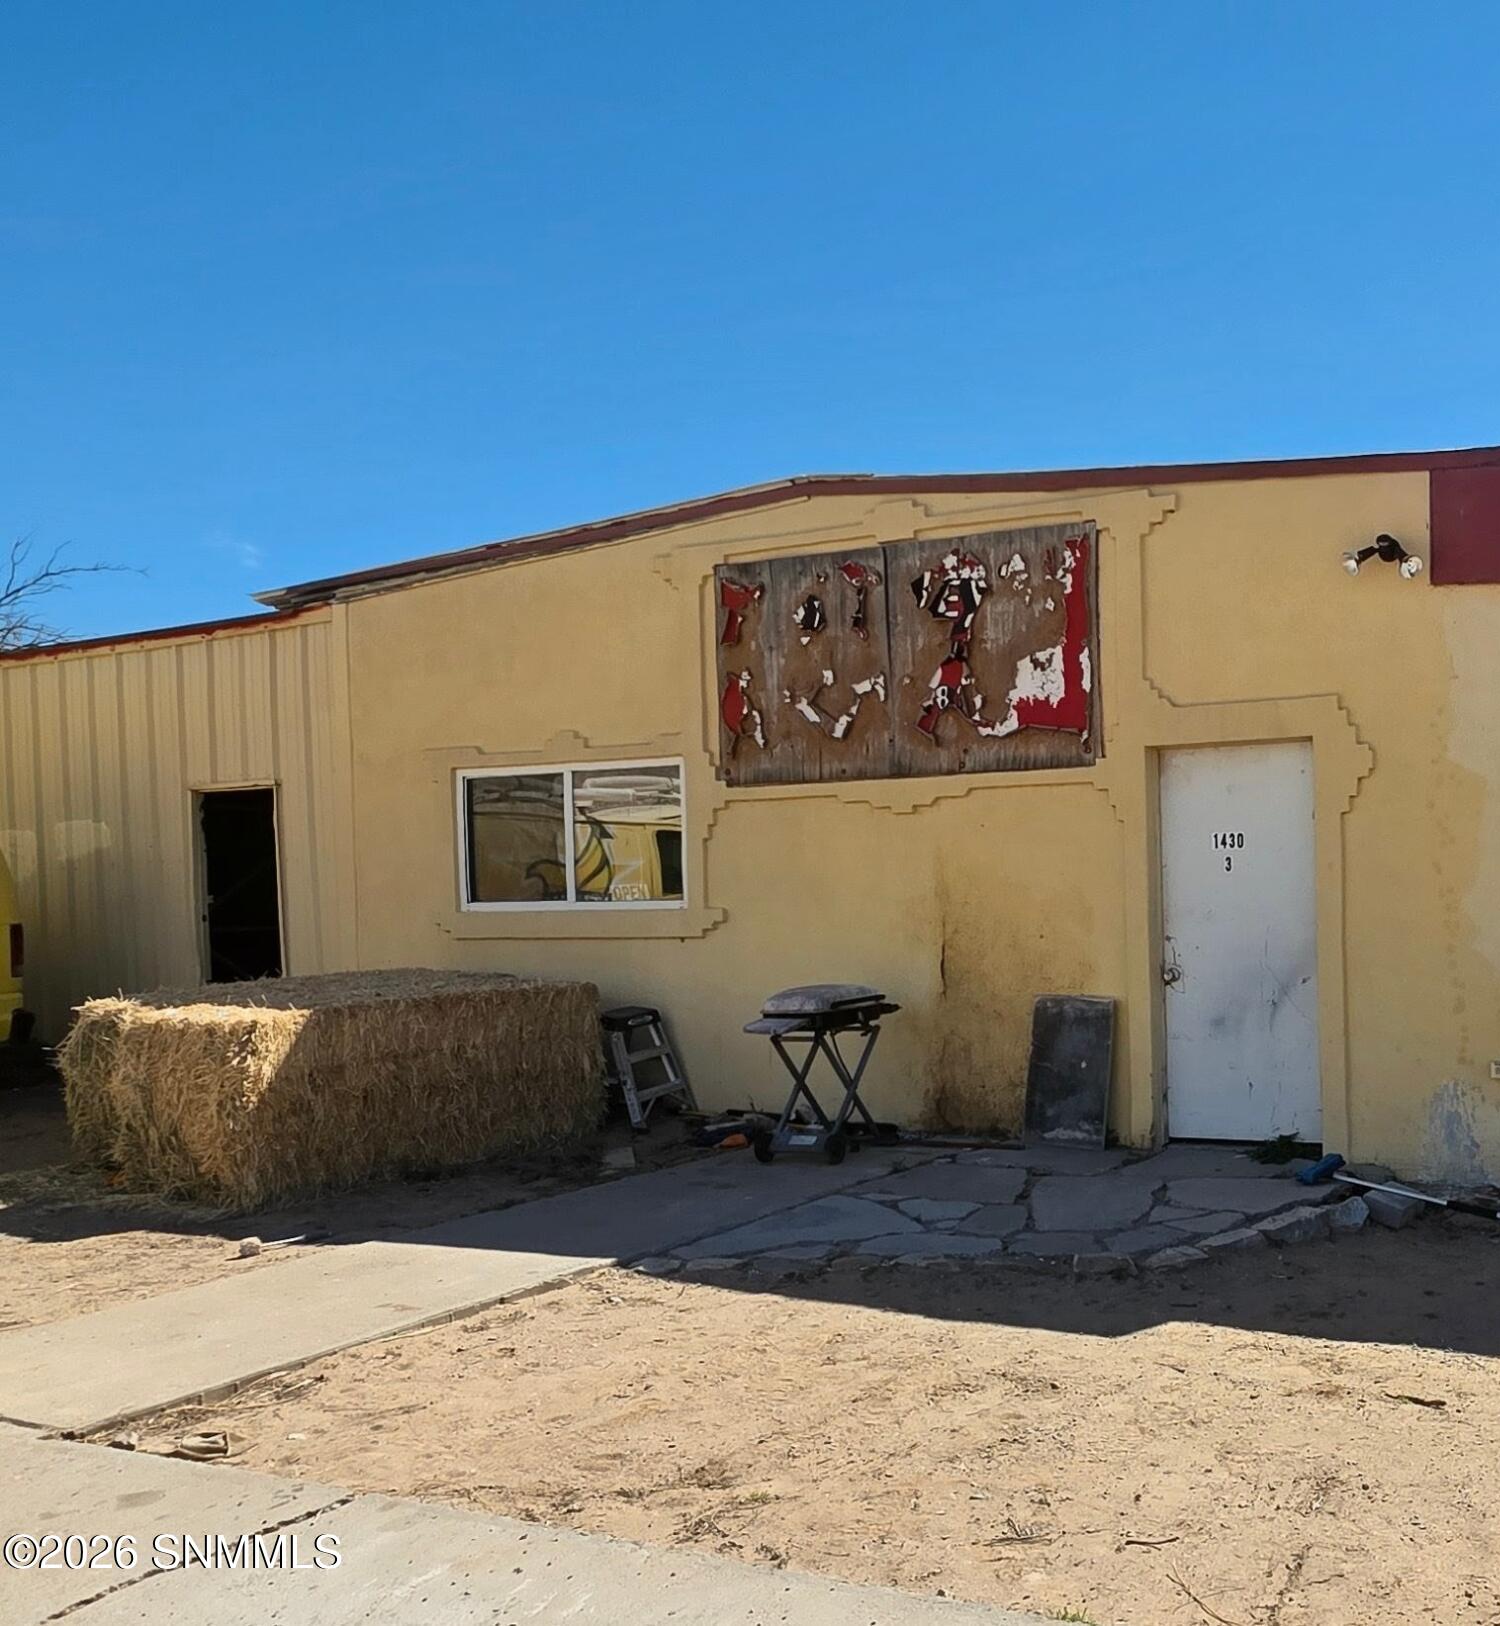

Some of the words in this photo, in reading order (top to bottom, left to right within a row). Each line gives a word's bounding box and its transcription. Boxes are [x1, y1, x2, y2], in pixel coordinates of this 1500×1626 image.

[1213, 832, 1244, 849] 1430
[1225, 856, 1232, 872] 3
[612, 885, 647, 900] OPEN
